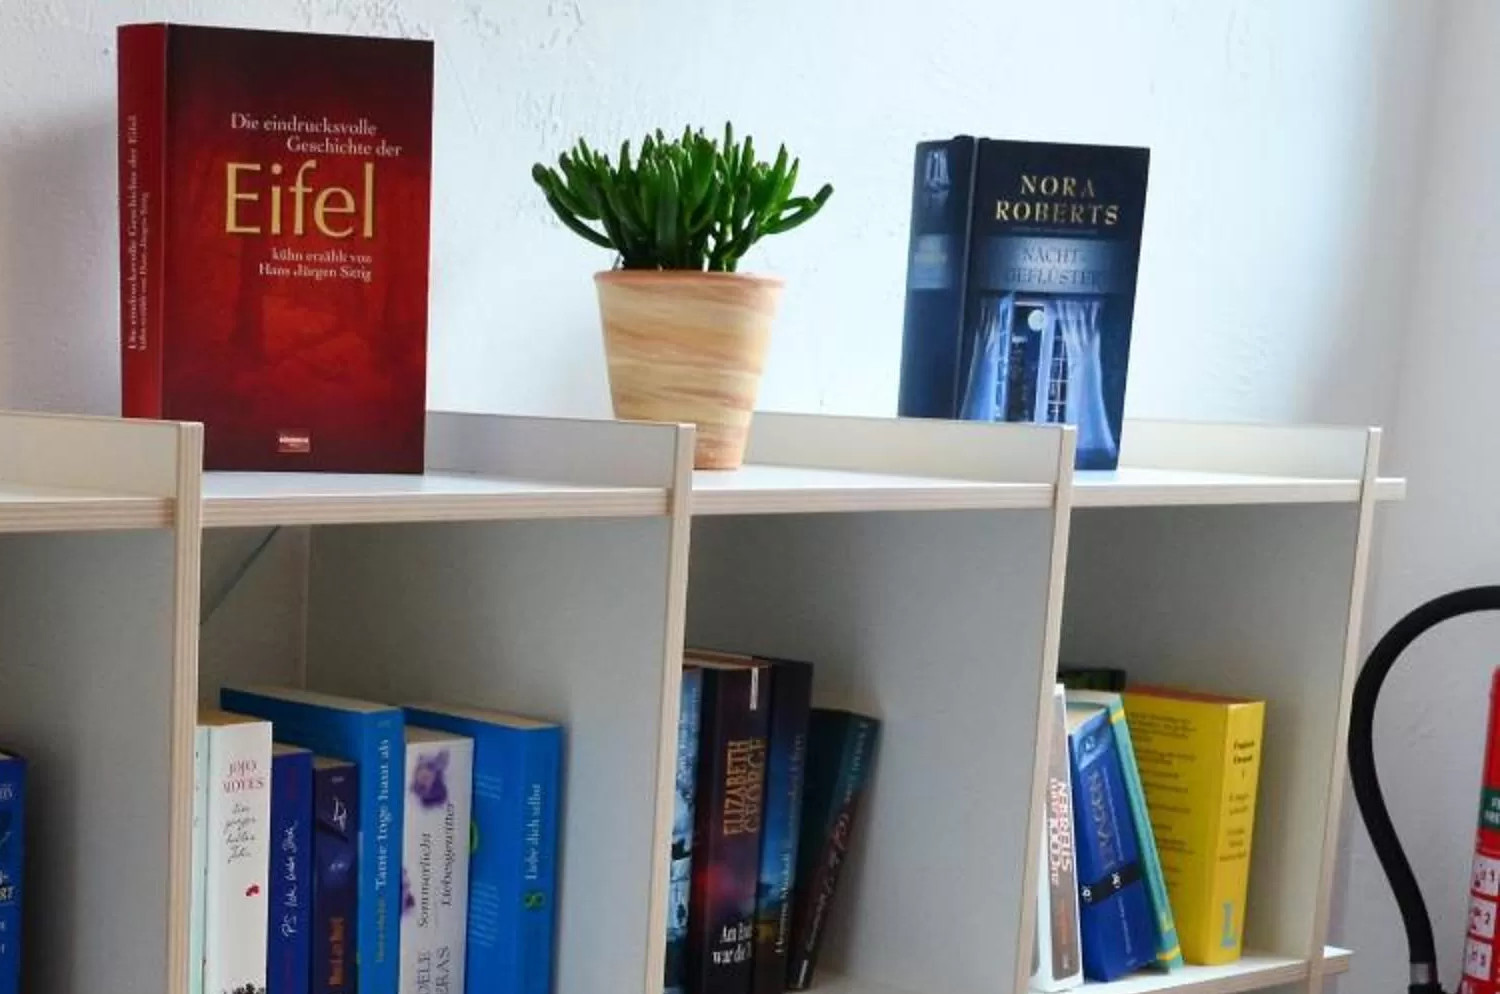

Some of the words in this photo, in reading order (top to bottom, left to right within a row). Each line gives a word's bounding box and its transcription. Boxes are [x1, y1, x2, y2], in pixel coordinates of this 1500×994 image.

[231, 113, 259, 131] Die
[264, 115, 377, 136] eindrucksvolle
[287, 137, 372, 155] Geschichte
[375, 139, 402, 157] der
[1020, 174, 1097, 198] NORA
[225, 160, 373, 238] Eifel
[996, 199, 1120, 225] ROBERTS
[272, 248, 304, 263] kühn
[306, 249, 347, 264] erzählt
[349, 253, 372, 264] von
[259, 263, 291, 277] Hans
[723, 740, 748, 836] ELIZABETH
[744, 736, 766, 834] GEORGE
